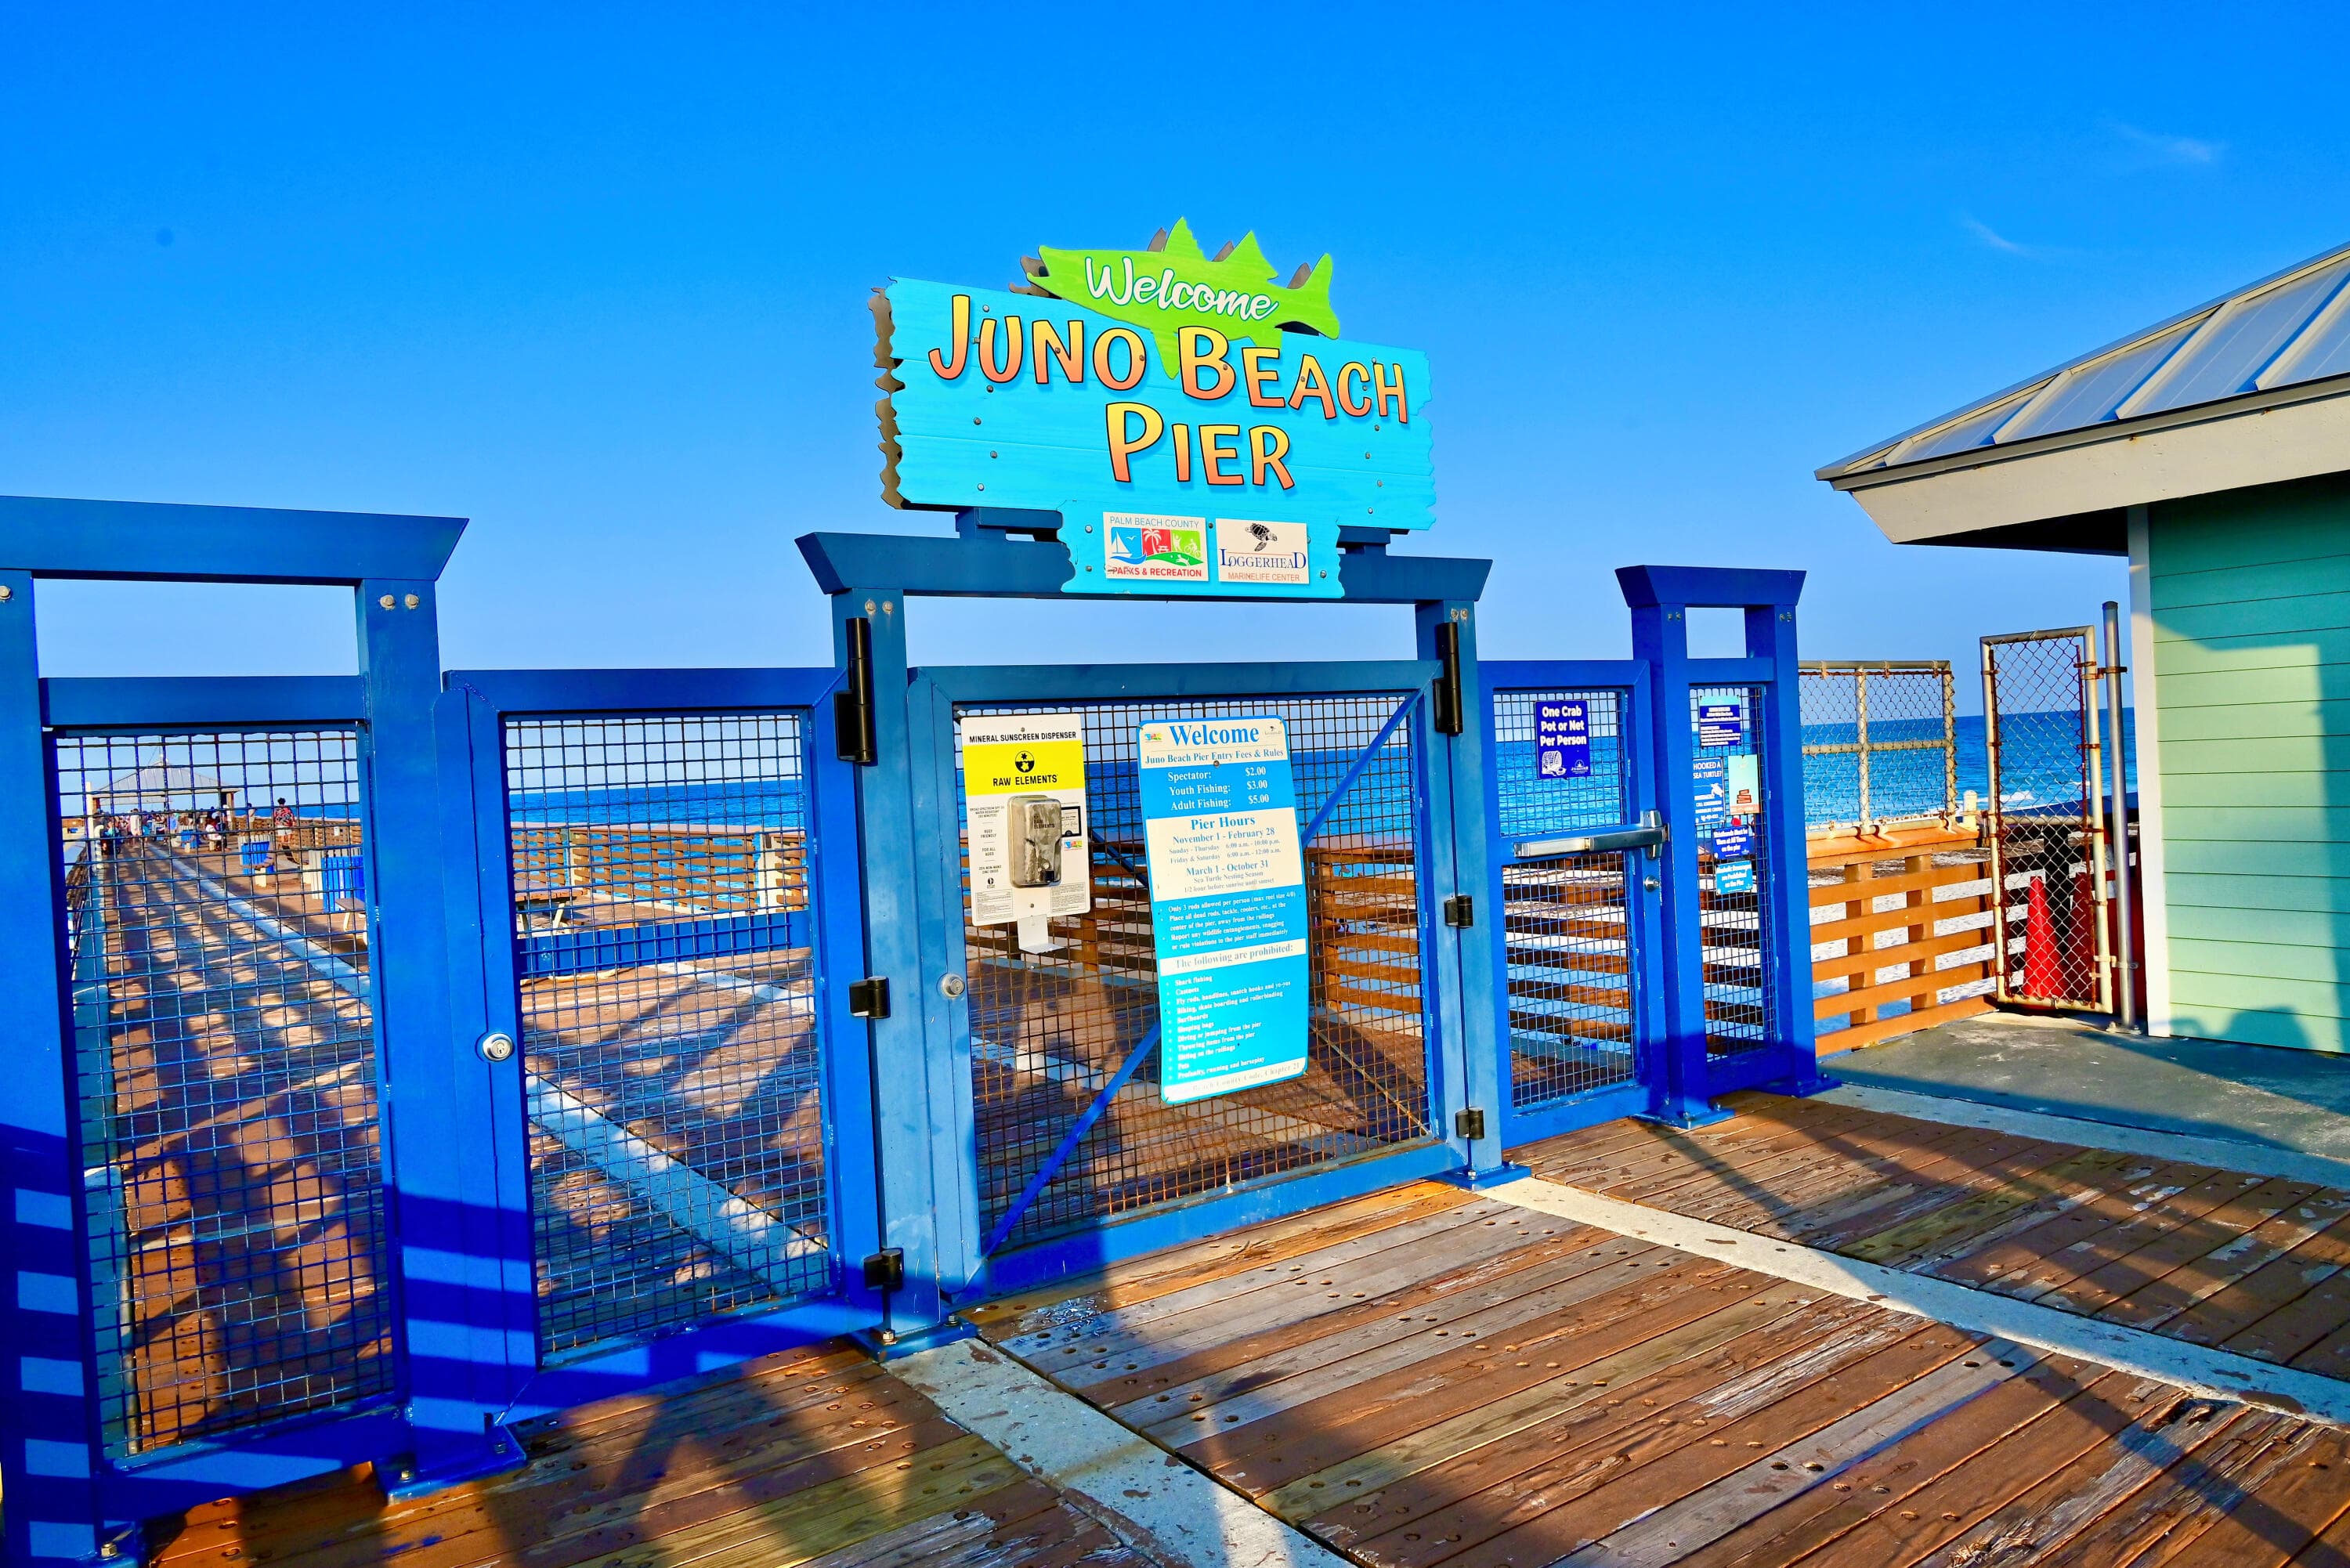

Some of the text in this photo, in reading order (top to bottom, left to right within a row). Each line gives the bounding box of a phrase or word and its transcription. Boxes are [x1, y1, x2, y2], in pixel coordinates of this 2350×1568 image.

[1084, 256, 1279, 321] Welcome
[928, 294, 1408, 424] JUNO BEACH
[1104, 401, 1295, 490] PIER
[1109, 516, 1199, 528] PALM BEACH COUNTY
[1219, 548, 1307, 569] LOGGERHEAD
[1112, 566, 1202, 577] PARKS & RECREATION
[1227, 572, 1271, 580] MARINELIFE
[1542, 705, 1582, 717] One Crab
[1541, 720, 1585, 732] Pot or Net
[969, 731, 1077, 743] MINERAL SUNSCREEN DISPENSER
[1169, 724, 1260, 746] Welcome
[1539, 735, 1587, 746] Per Person
[1167, 753, 1191, 762] Beach
[1193, 753, 1209, 761] Pier
[1211, 752, 1233, 761] Entry
[1693, 761, 1716, 770] HOOKED
[992, 775, 1058, 786] RAW ELEMENTS
[1168, 766, 1266, 783] Spectator: $2.00
[1169, 779, 1267, 796] Youth Fishing: $3.00
[1171, 793, 1269, 810] Adult Fishing: $5.00
[1191, 816, 1256, 830] Pier Hours
[1173, 834, 1213, 844] November
[1228, 830, 1264, 839] February
[1187, 866, 1213, 876] March
[1227, 862, 1258, 871] October
[1260, 859, 1268, 868] 31
[1171, 933, 1190, 941] Report
[1223, 923, 1262, 933] entanglements,
[1262, 920, 1285, 929] snagging
[1258, 928, 1289, 938] immediately
[1177, 958, 1191, 967] The
[1194, 953, 1233, 965] following
[1249, 943, 1293, 959] prohibited:
[1202, 992, 1229, 1000] handlines,
[1213, 999, 1238, 1008] boarding
[1249, 991, 1283, 1001] rollerblading
[1177, 1013, 1209, 1024] Surfboards
[1177, 1034, 1196, 1042] Diving
[1205, 1028, 1227, 1038] jumping
[1178, 1042, 1205, 1051] Throwing
[1215, 1045, 1235, 1053] railings
[1206, 1064, 1229, 1073] running
[1240, 1057, 1265, 1066] horseplay
[1265, 1065, 1290, 1076] Chapter
